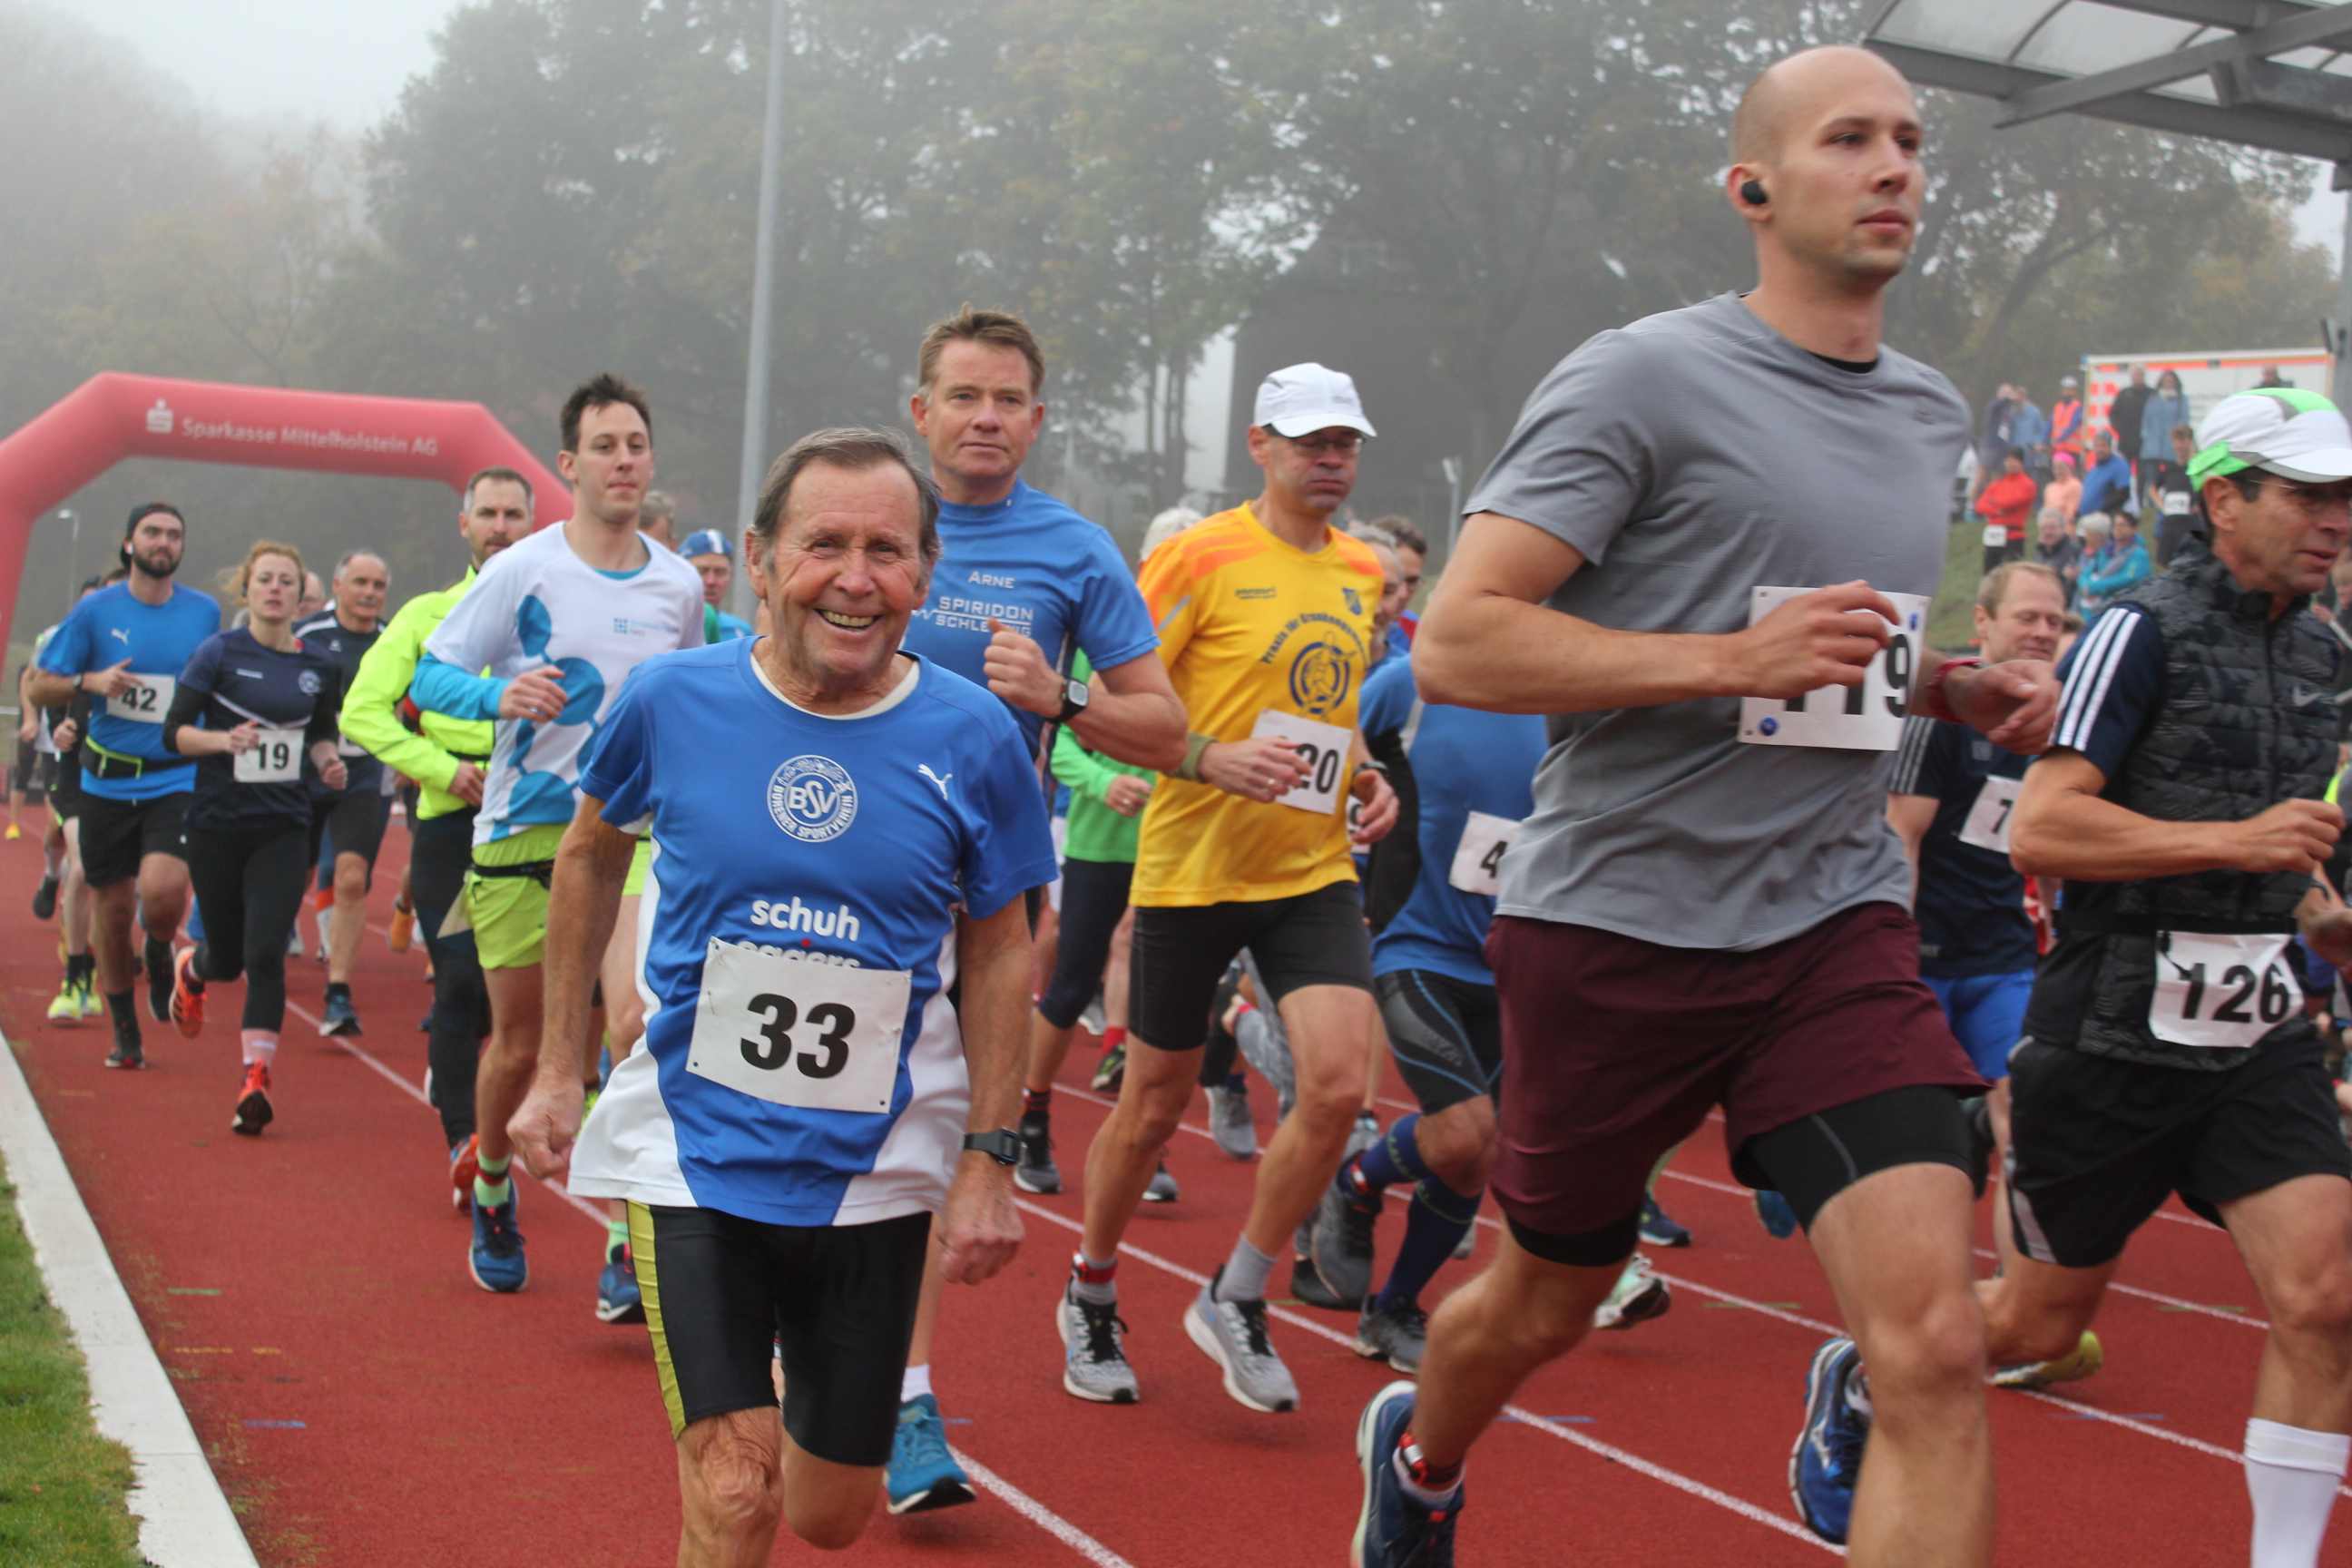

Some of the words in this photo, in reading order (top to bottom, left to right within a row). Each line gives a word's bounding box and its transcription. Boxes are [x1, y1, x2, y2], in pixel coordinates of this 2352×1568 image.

[181, 417, 276, 444] Sparkasse
[280, 425, 407, 453] Mittelholstein
[411, 435, 437, 456] AG
[967, 571, 1016, 589] ARNE
[938, 595, 1034, 621] SPIRIDON
[936, 614, 1032, 638] SCHLEIG
[121, 687, 158, 712] 42
[257, 742, 290, 770] 19
[788, 779, 837, 819] BSV
[750, 896, 860, 941] schuh
[2180, 963, 2290, 1024] 126
[740, 993, 856, 1079] 33
